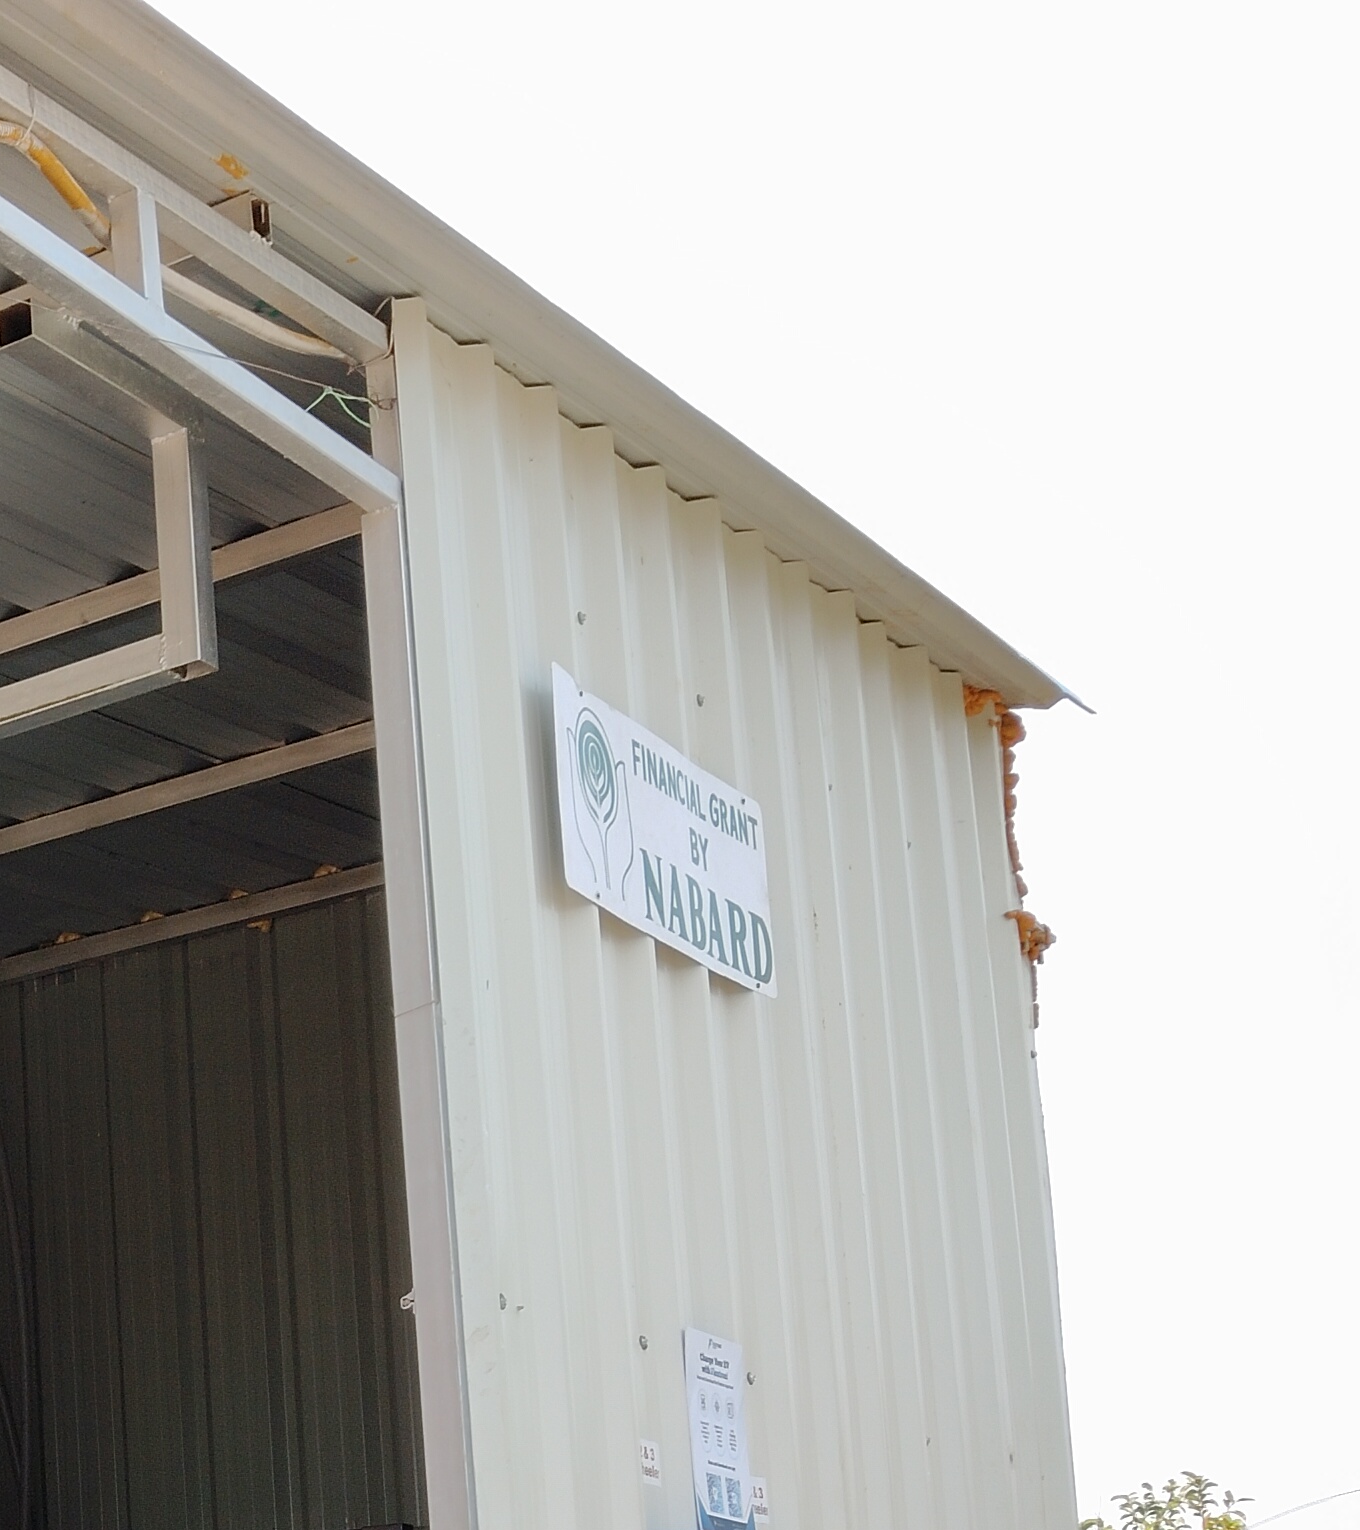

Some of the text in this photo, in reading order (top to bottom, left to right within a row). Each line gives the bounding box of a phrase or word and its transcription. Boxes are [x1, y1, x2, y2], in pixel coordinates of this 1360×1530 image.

[631, 739, 758, 851] FINANCIAL GRANT
[688, 826, 709, 872] BY
[639, 847, 773, 986] NABARD
